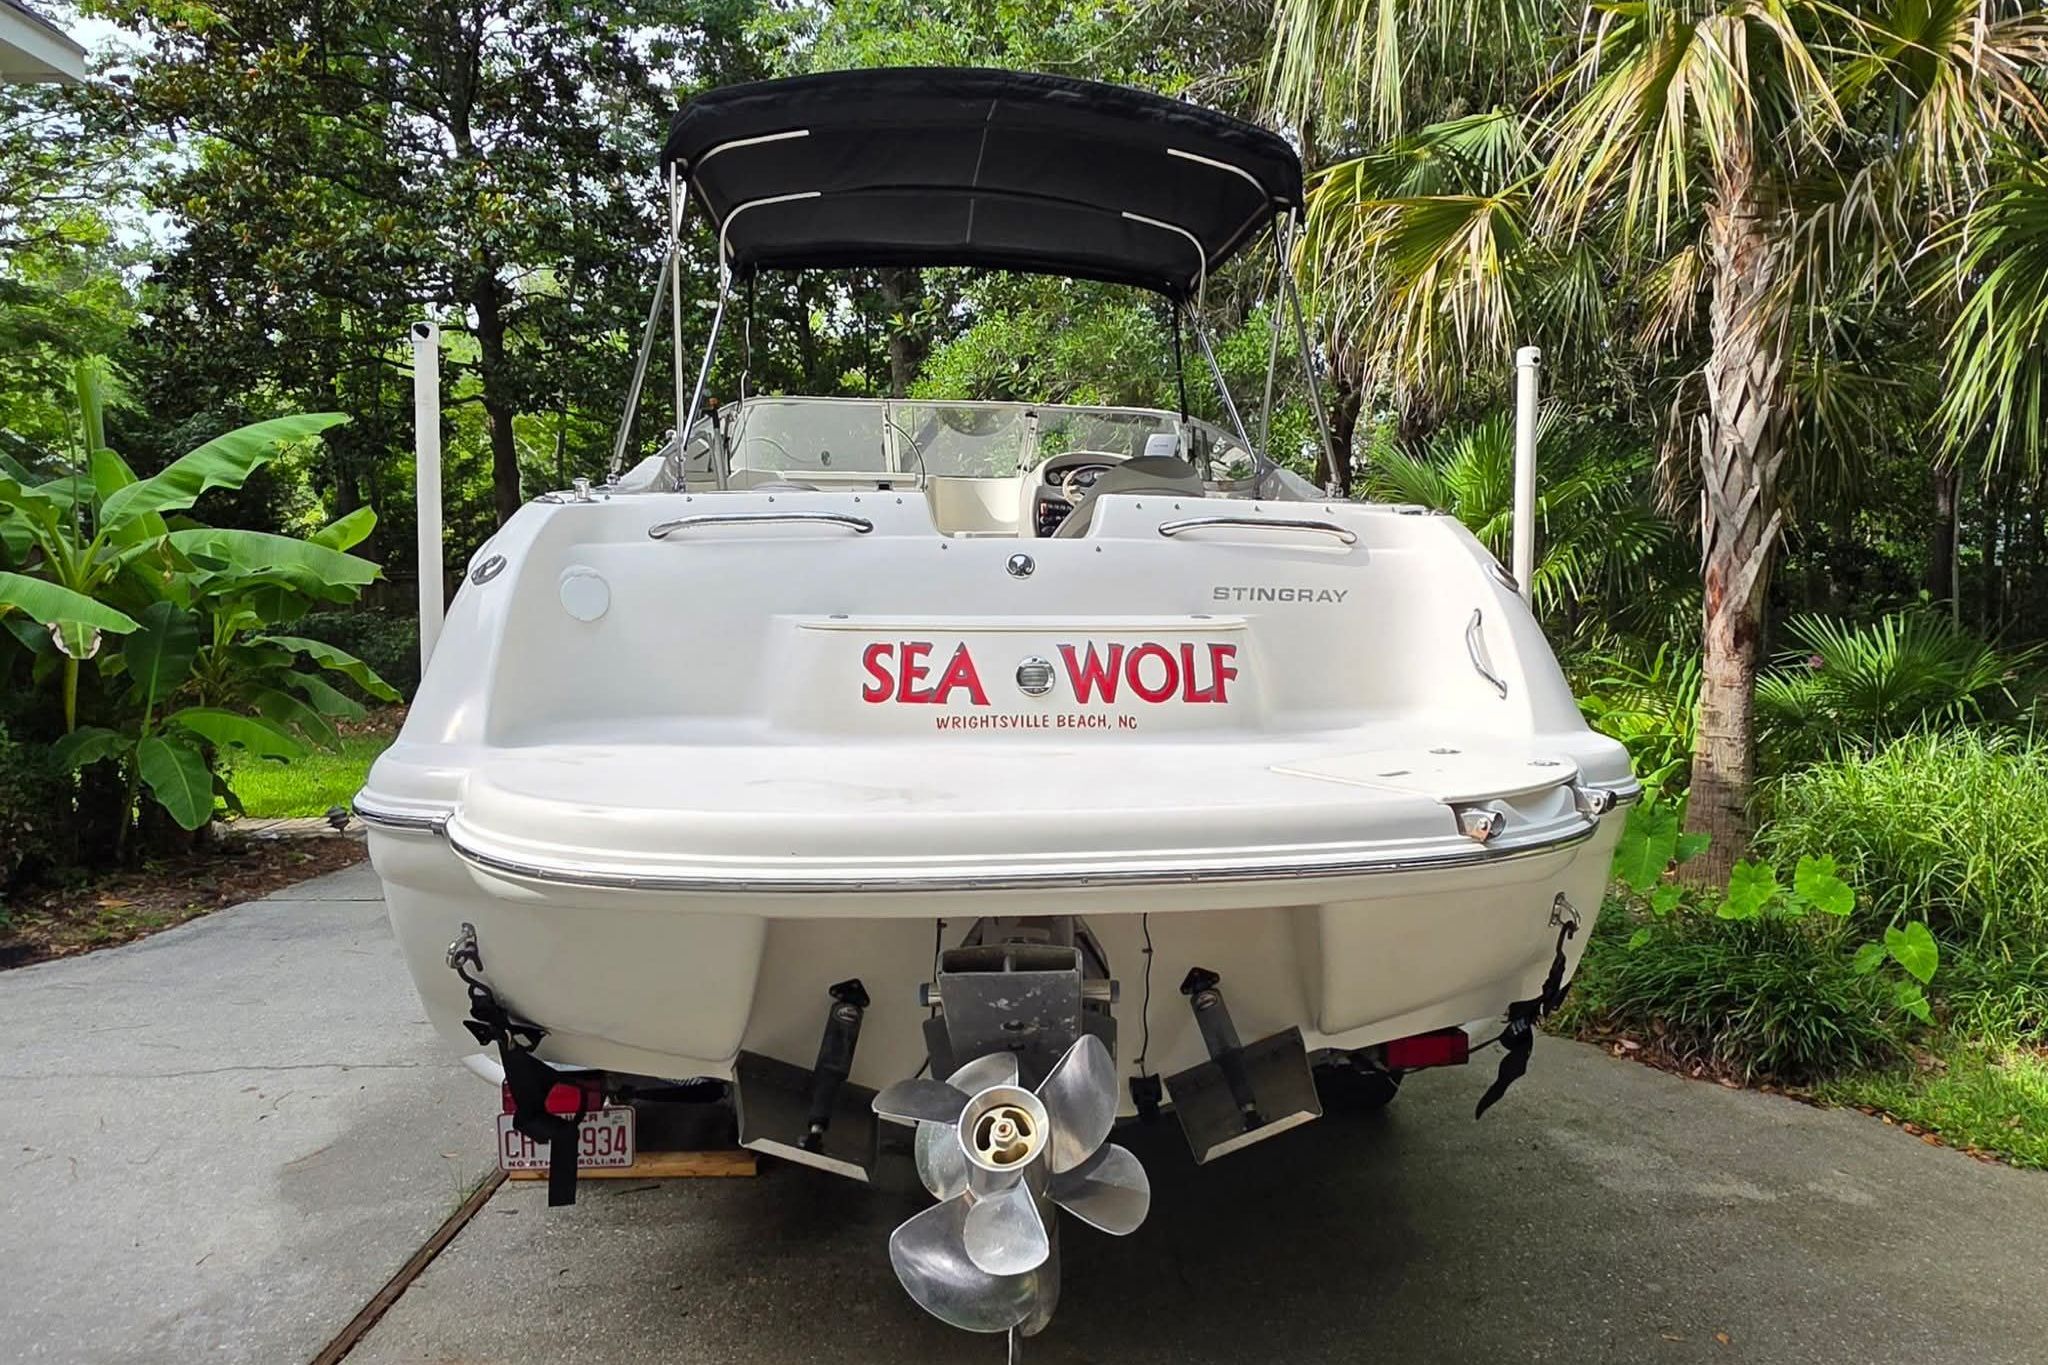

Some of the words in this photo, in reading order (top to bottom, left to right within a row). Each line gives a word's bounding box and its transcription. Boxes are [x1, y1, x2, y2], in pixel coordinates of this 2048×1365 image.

[1213, 586, 1349, 603] STINGRAY
[861, 641, 991, 706] SEA
[1056, 640, 1239, 705] WOLF
[935, 714, 1050, 730] WRIGHTSVILLE
[1056, 714, 1113, 732] BEACH,
[1117, 714, 1138, 730] NC
